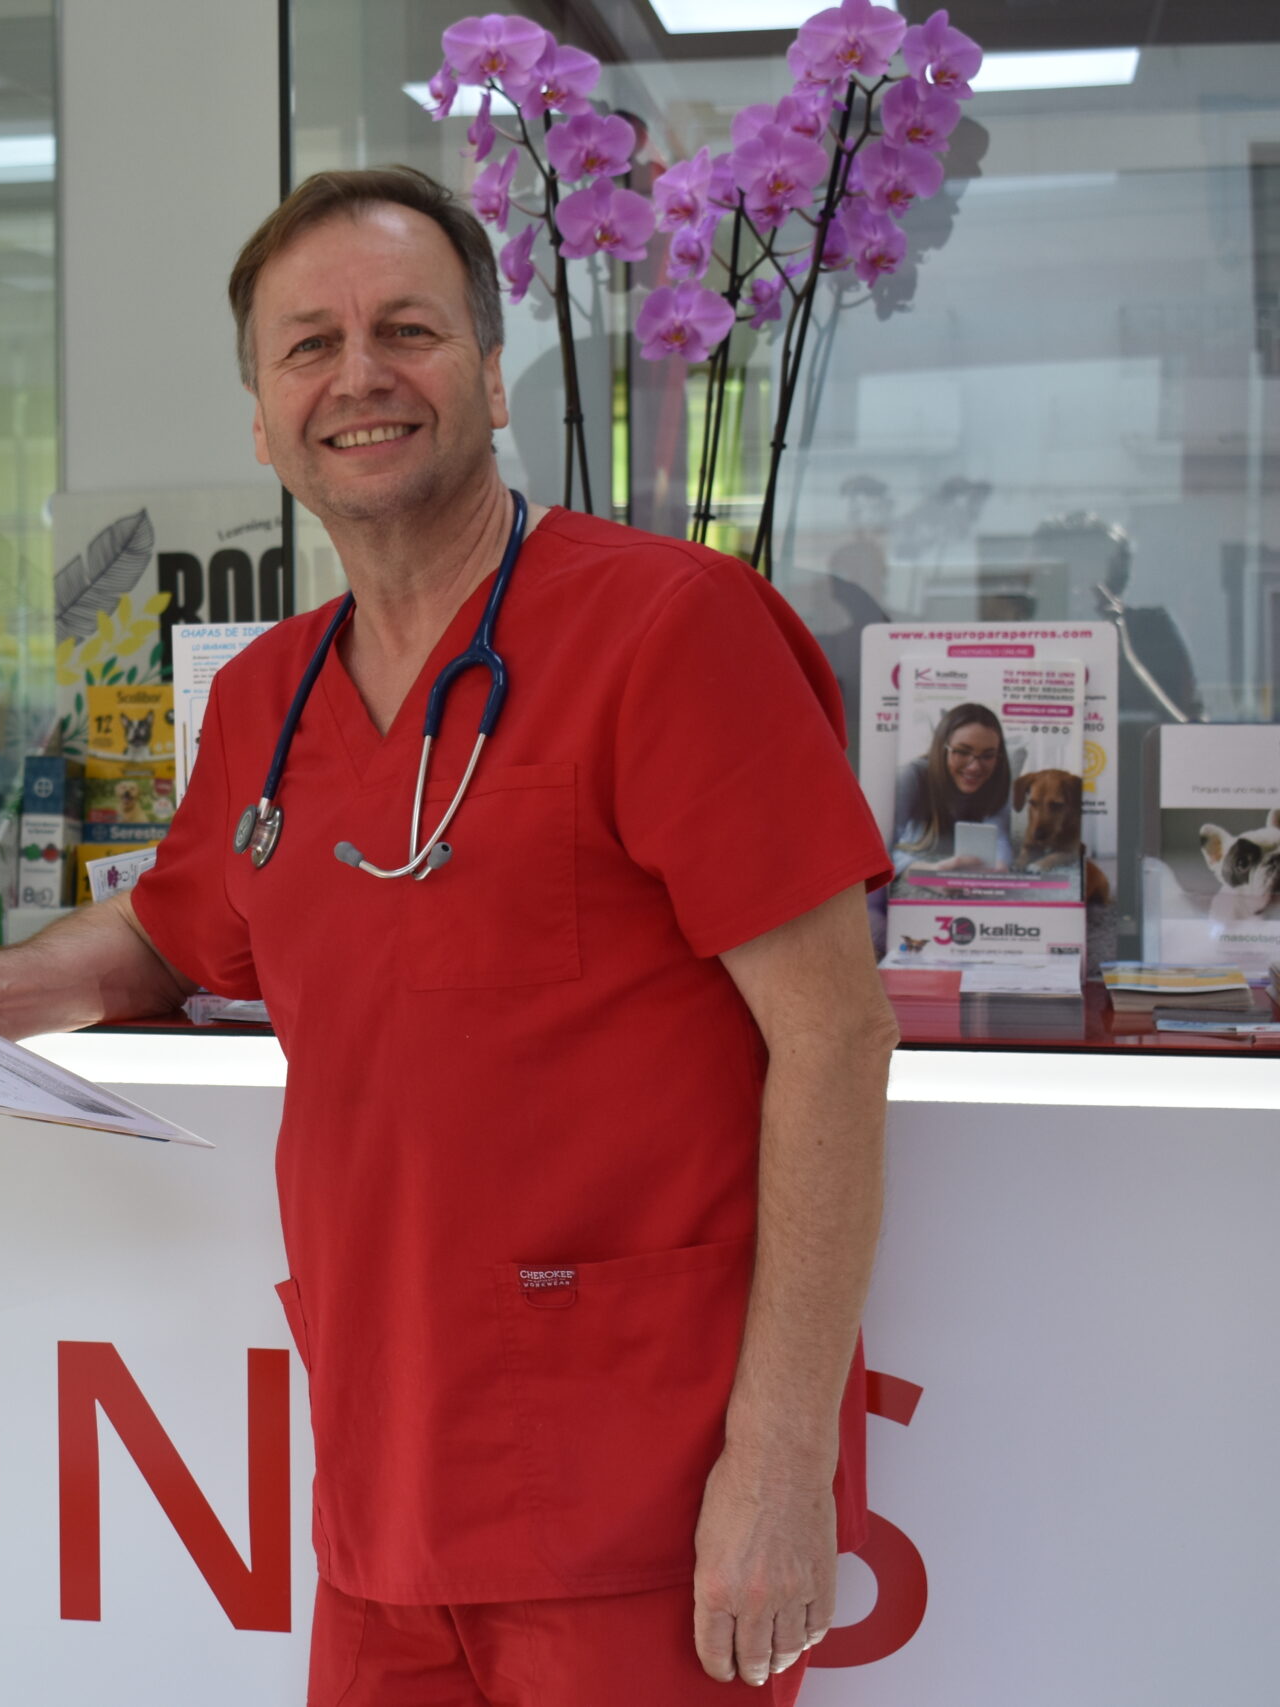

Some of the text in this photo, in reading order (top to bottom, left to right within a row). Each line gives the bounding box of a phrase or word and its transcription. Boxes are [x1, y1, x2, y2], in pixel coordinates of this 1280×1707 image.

[225, 627, 239, 637] DE
[889, 629, 1093, 641] www.seguroparaperros.com
[979, 923, 1041, 937] kalibo
[520, 1270, 574, 1280] CHEROKEE
[523, 1280, 570, 1288] WORKWEAR
